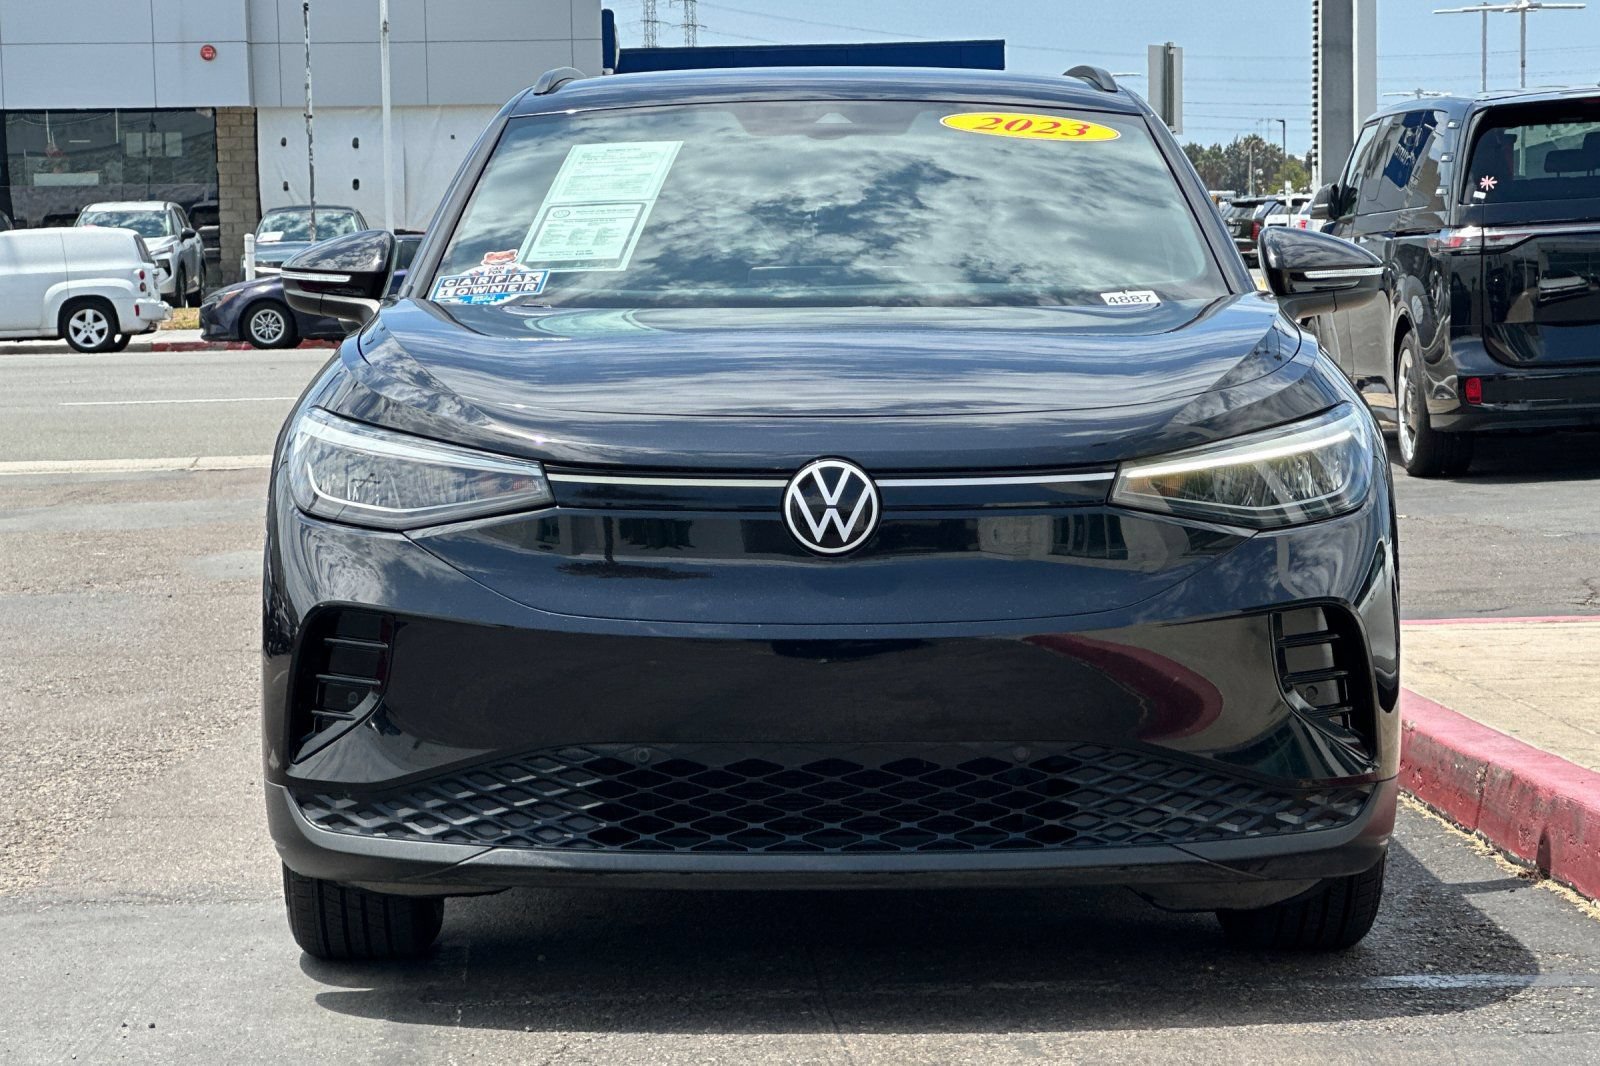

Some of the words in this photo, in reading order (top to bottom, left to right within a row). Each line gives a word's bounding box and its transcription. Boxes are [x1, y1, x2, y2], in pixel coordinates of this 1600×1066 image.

[973, 117, 1091, 136] 2023
[444, 275, 539, 287] CARFAX
[457, 283, 537, 296] OWNER
[1107, 295, 1151, 304] 4887
